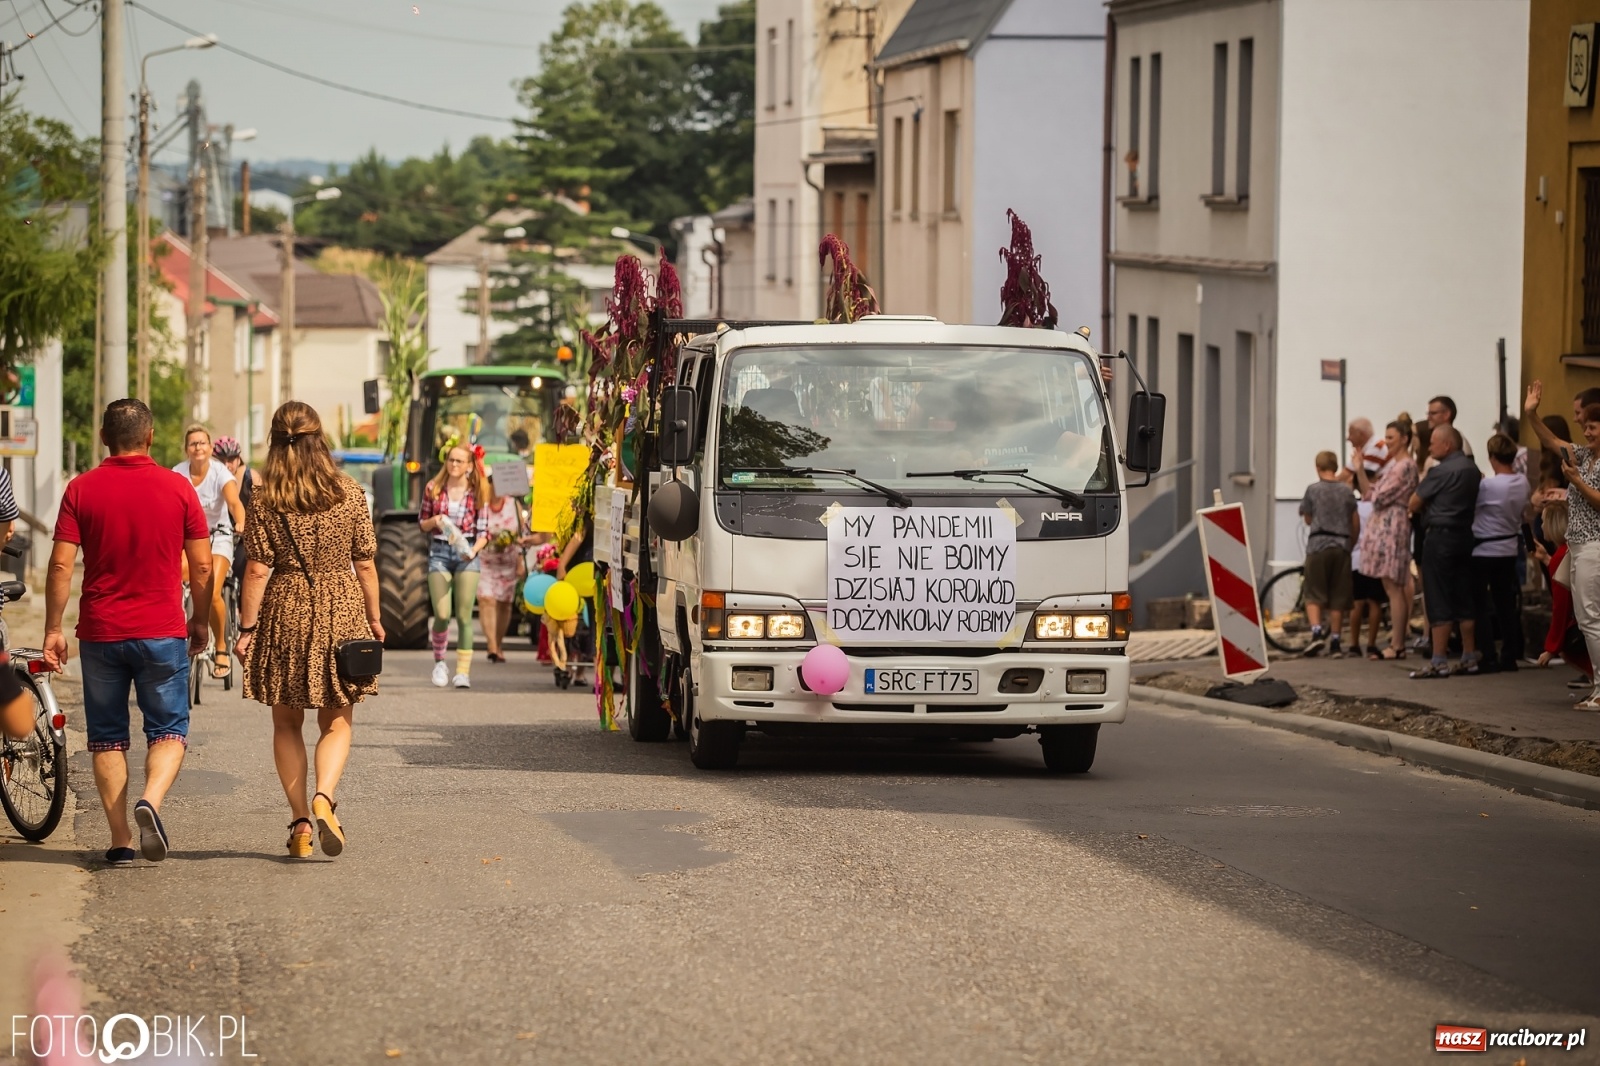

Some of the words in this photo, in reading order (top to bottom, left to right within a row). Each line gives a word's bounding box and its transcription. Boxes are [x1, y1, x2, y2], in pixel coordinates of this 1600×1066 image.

[844, 515, 875, 537] MY
[893, 515, 993, 539] PANDEMII
[1041, 512, 1083, 521] NPR
[844, 545, 881, 572] SIĘ
[898, 545, 934, 570] NIE
[944, 544, 1010, 571] BOIMY
[834, 577, 915, 601] DZISIAJ
[926, 577, 1015, 604] KOROWÓD
[832, 603, 953, 631] DOŻYNKOWY
[957, 609, 1015, 632] ROBIMY
[879, 671, 916, 691] SRC
[924, 671, 973, 691] FT75
